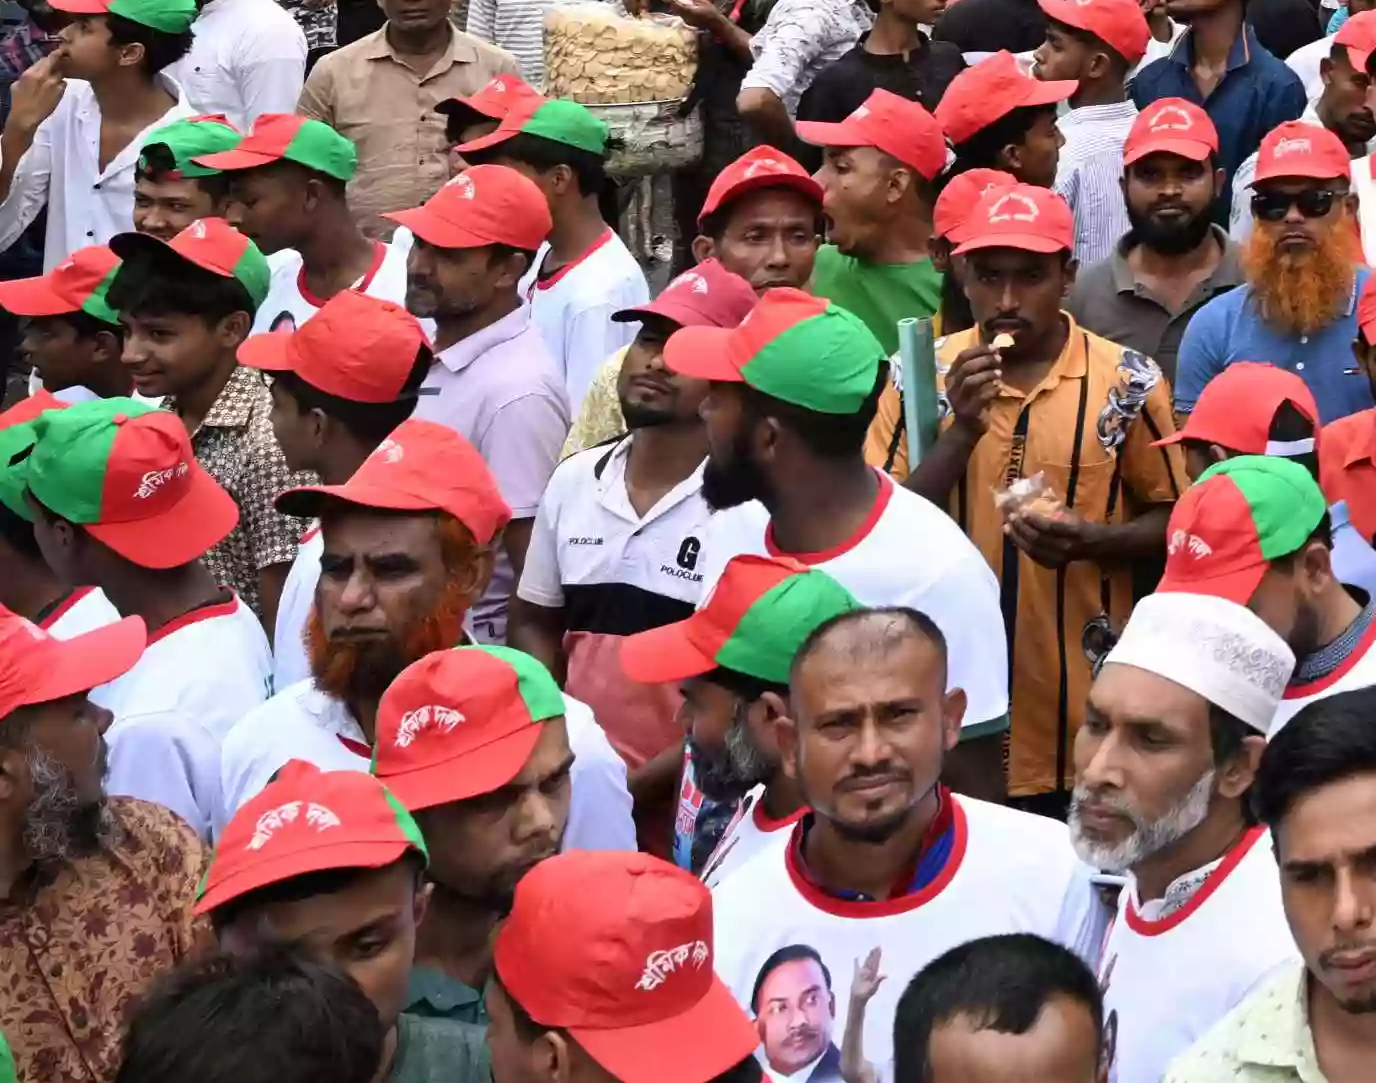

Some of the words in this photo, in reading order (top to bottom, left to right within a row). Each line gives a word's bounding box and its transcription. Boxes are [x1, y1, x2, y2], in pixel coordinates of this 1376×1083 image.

[131, 470, 174, 499] শ্রমিক
[394, 704, 431, 748] শ্রমিক
[433, 704, 467, 734] দল
[243, 800, 303, 852] শ্রমিক
[305, 801, 342, 833] দল
[634, 941, 695, 991] শ্রমিক
